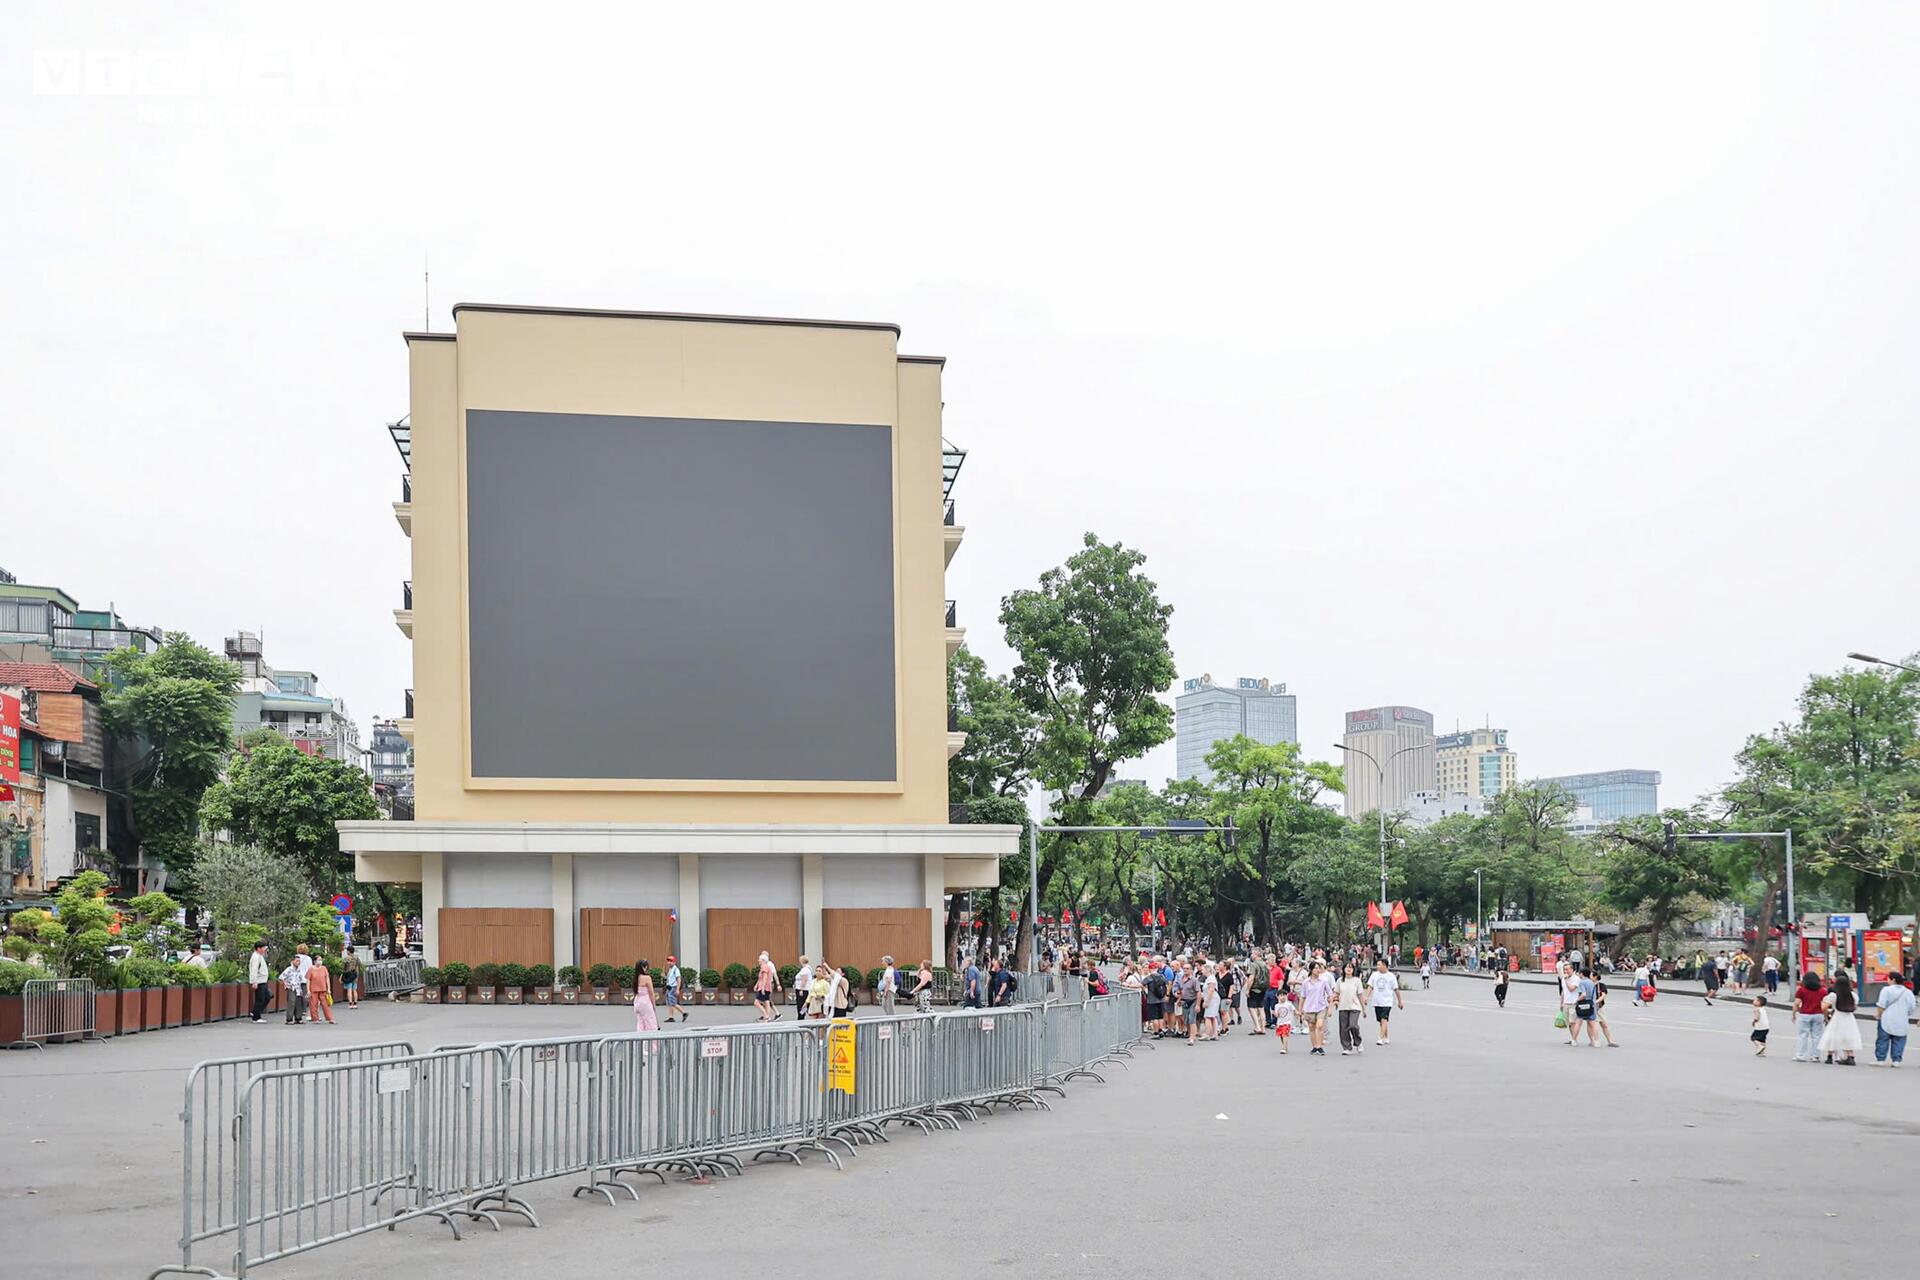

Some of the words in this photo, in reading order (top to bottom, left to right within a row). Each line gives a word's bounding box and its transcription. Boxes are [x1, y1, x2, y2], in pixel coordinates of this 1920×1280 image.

[1184, 676, 1204, 690] BIDV
[1240, 677, 1261, 688] BIDV
[539, 1050, 555, 1058] SOP
